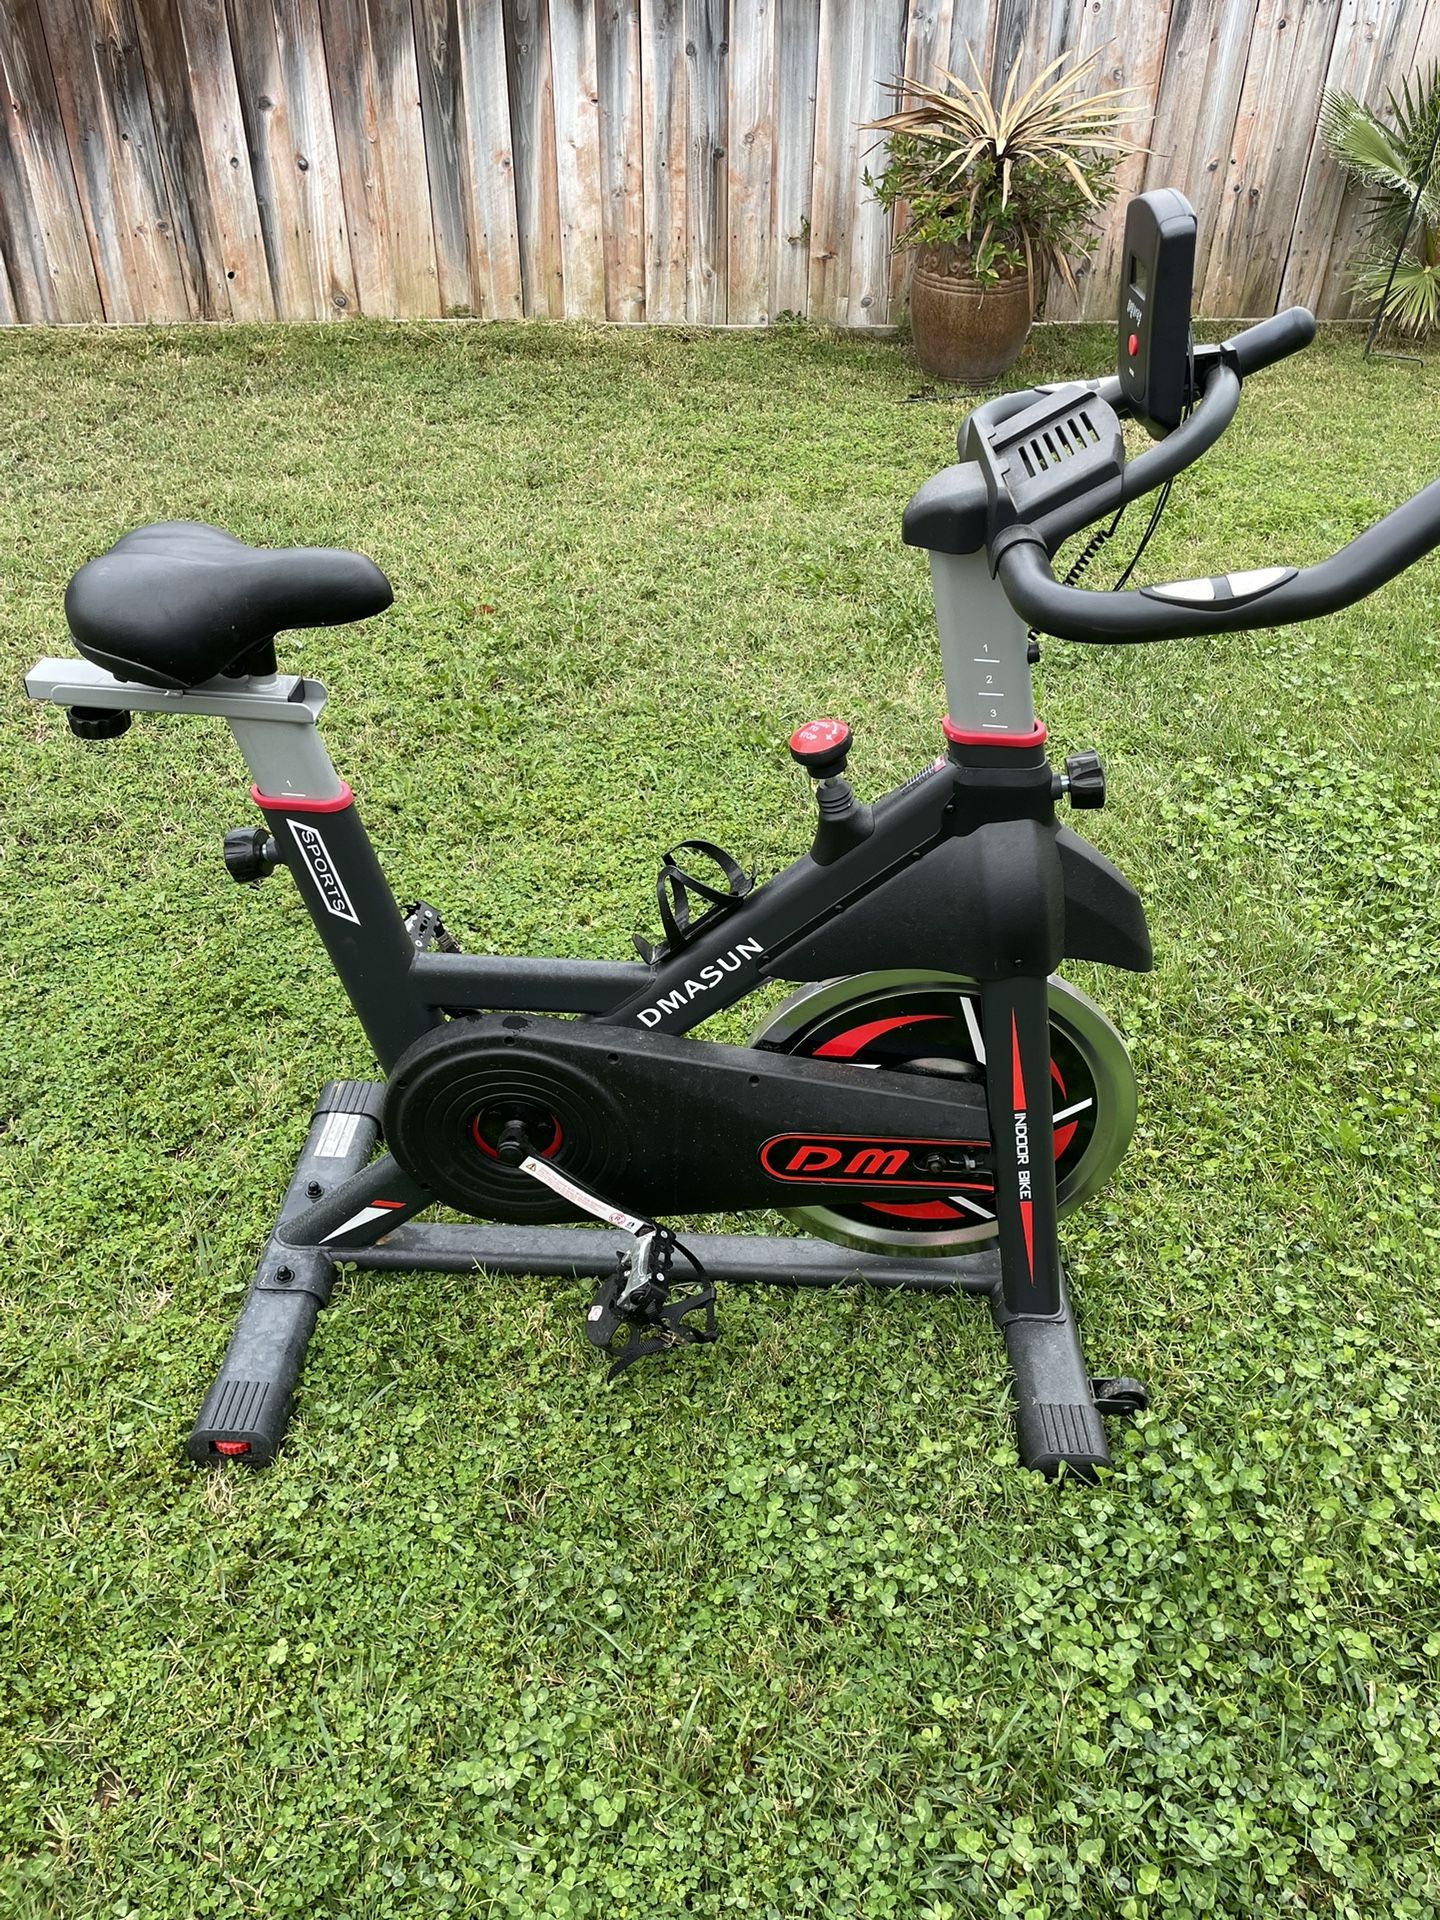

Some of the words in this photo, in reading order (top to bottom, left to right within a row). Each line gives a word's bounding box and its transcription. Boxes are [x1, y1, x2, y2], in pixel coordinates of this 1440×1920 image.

[982, 643, 989, 654] 1
[985, 674, 993, 684] 2
[989, 708, 997, 718] 3
[302, 830, 345, 912] SPORTS
[636, 936, 764, 1028] DMASUN
[1014, 1112, 1030, 1165] INDOOR
[1018, 1170, 1032, 1200] BIKE
